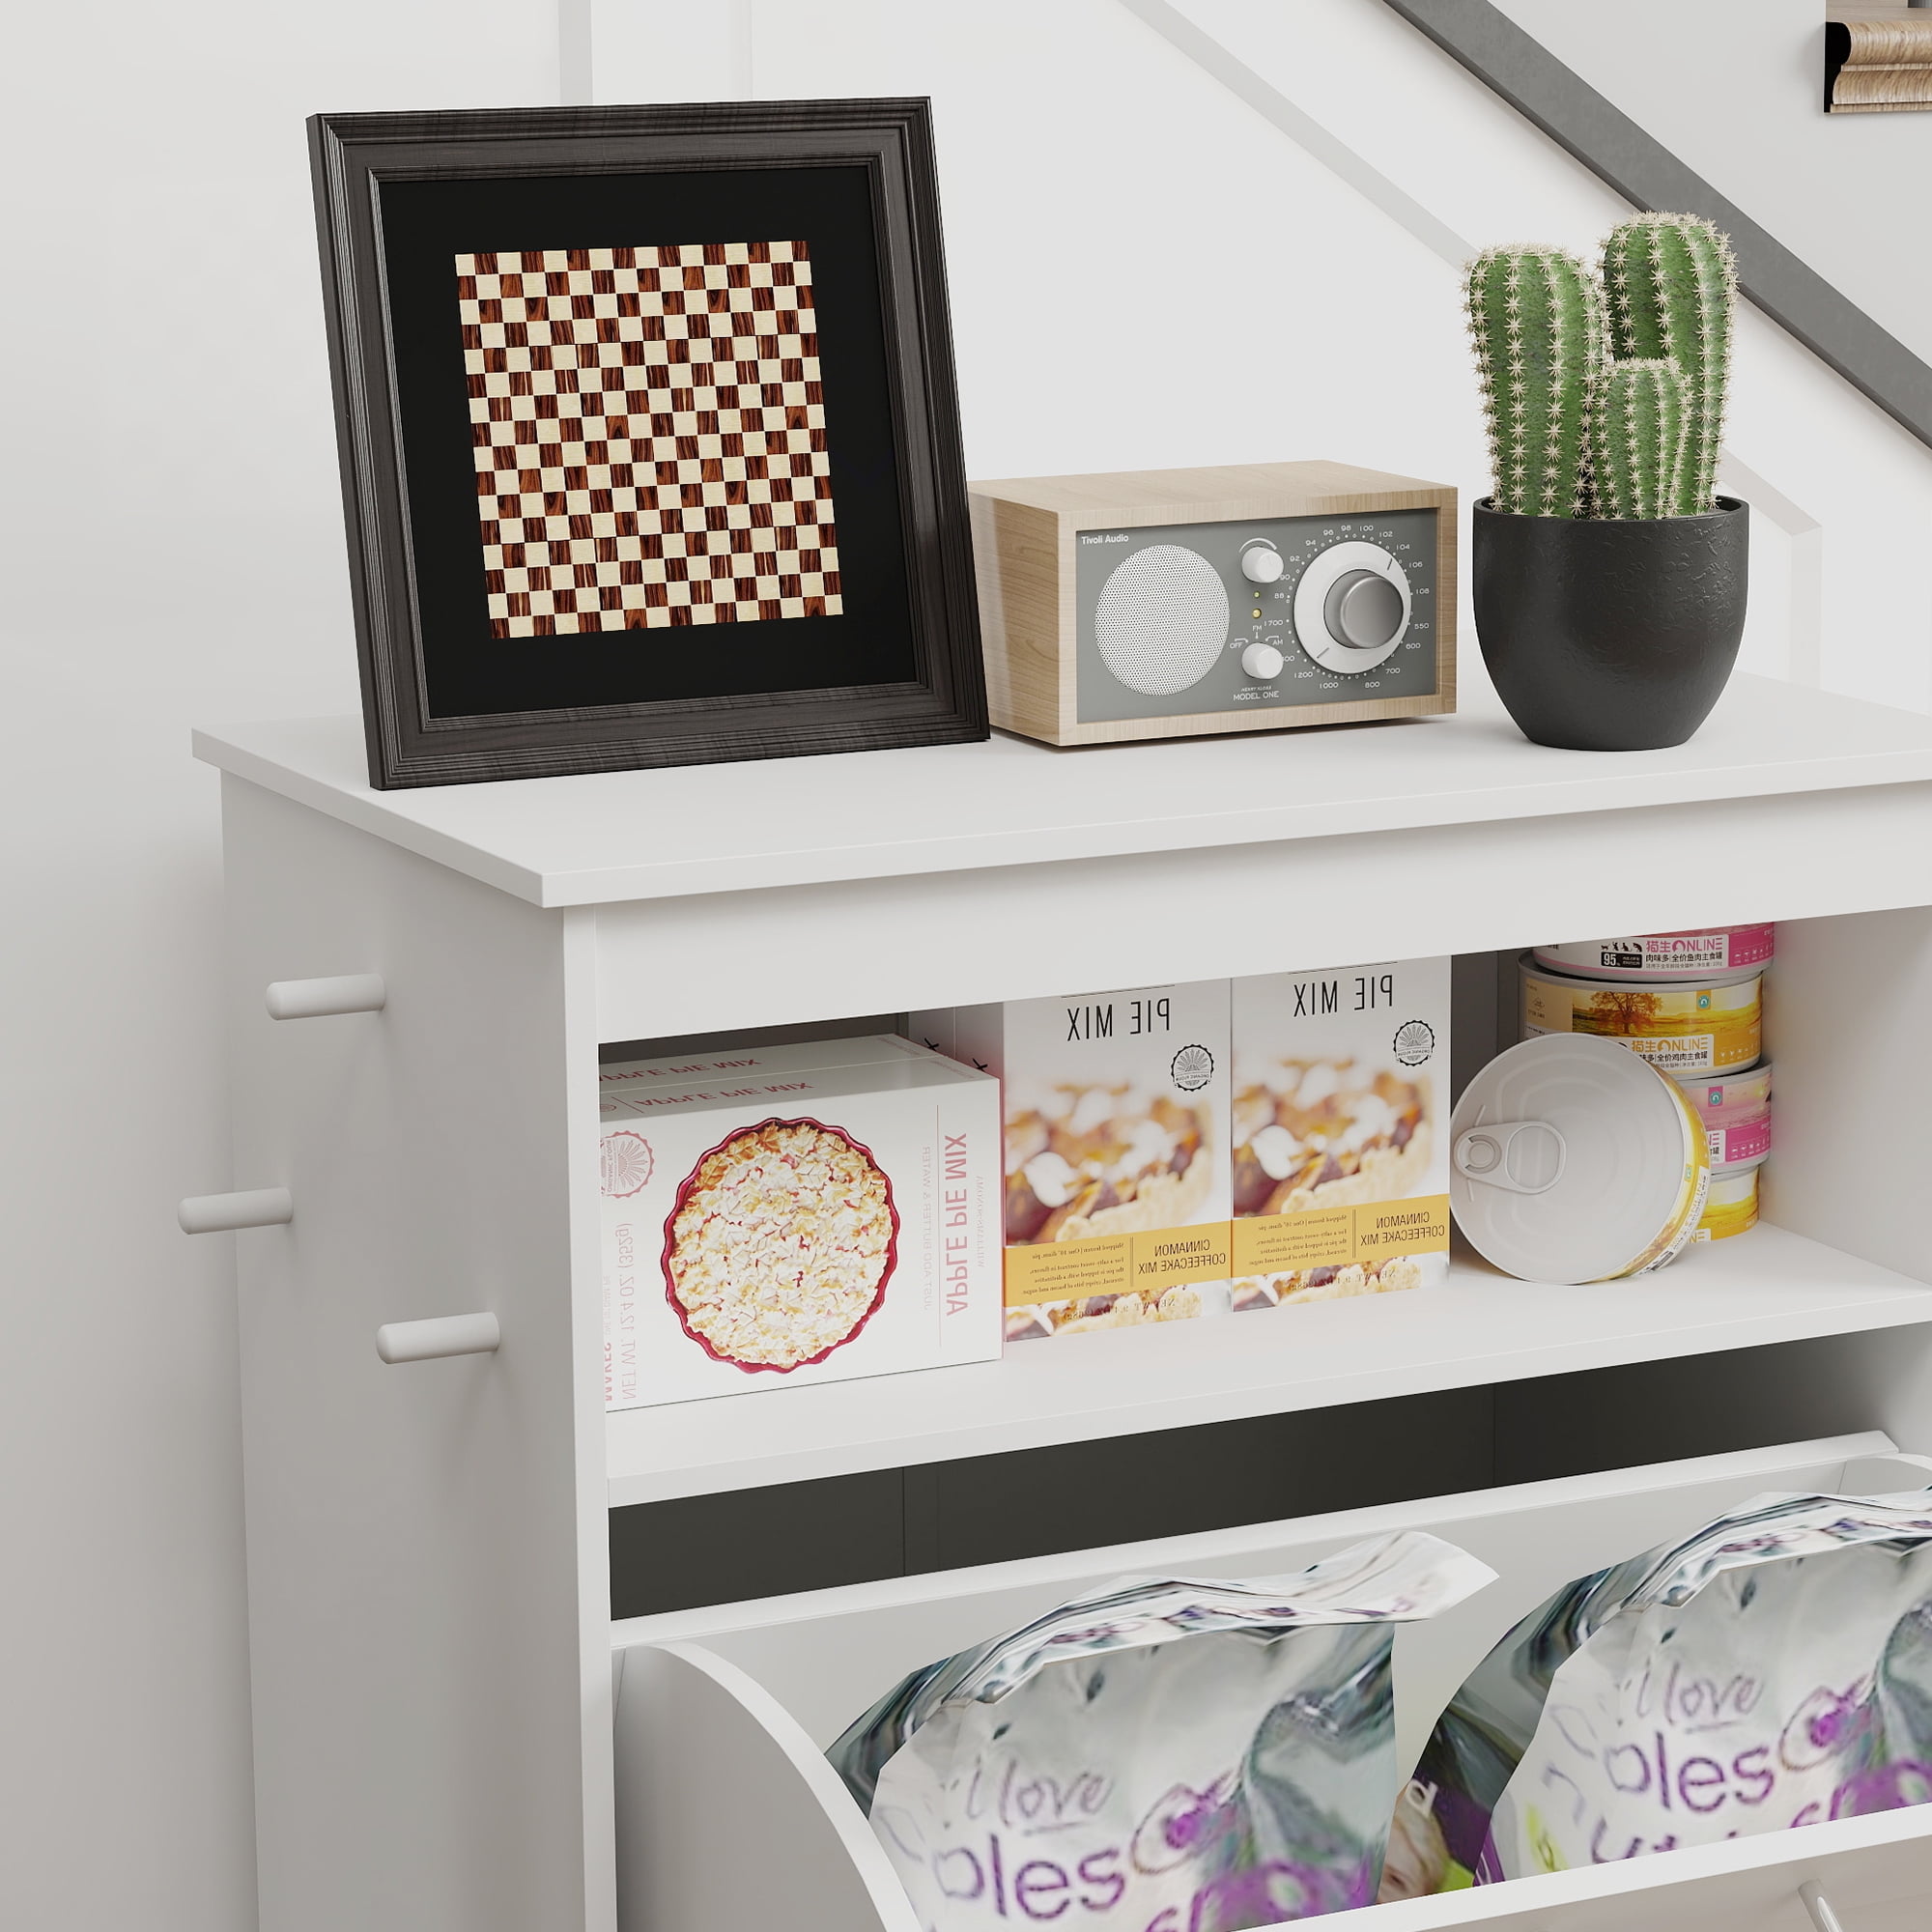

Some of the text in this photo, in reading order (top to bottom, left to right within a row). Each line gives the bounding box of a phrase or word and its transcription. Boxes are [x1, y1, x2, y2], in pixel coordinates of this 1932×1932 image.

[1081, 533, 1129, 545] Tivoli Audio
[1233, 692, 1261, 701] MODEL
[1663, 1661, 1767, 1726] love
[997, 1757, 1113, 1828] love
